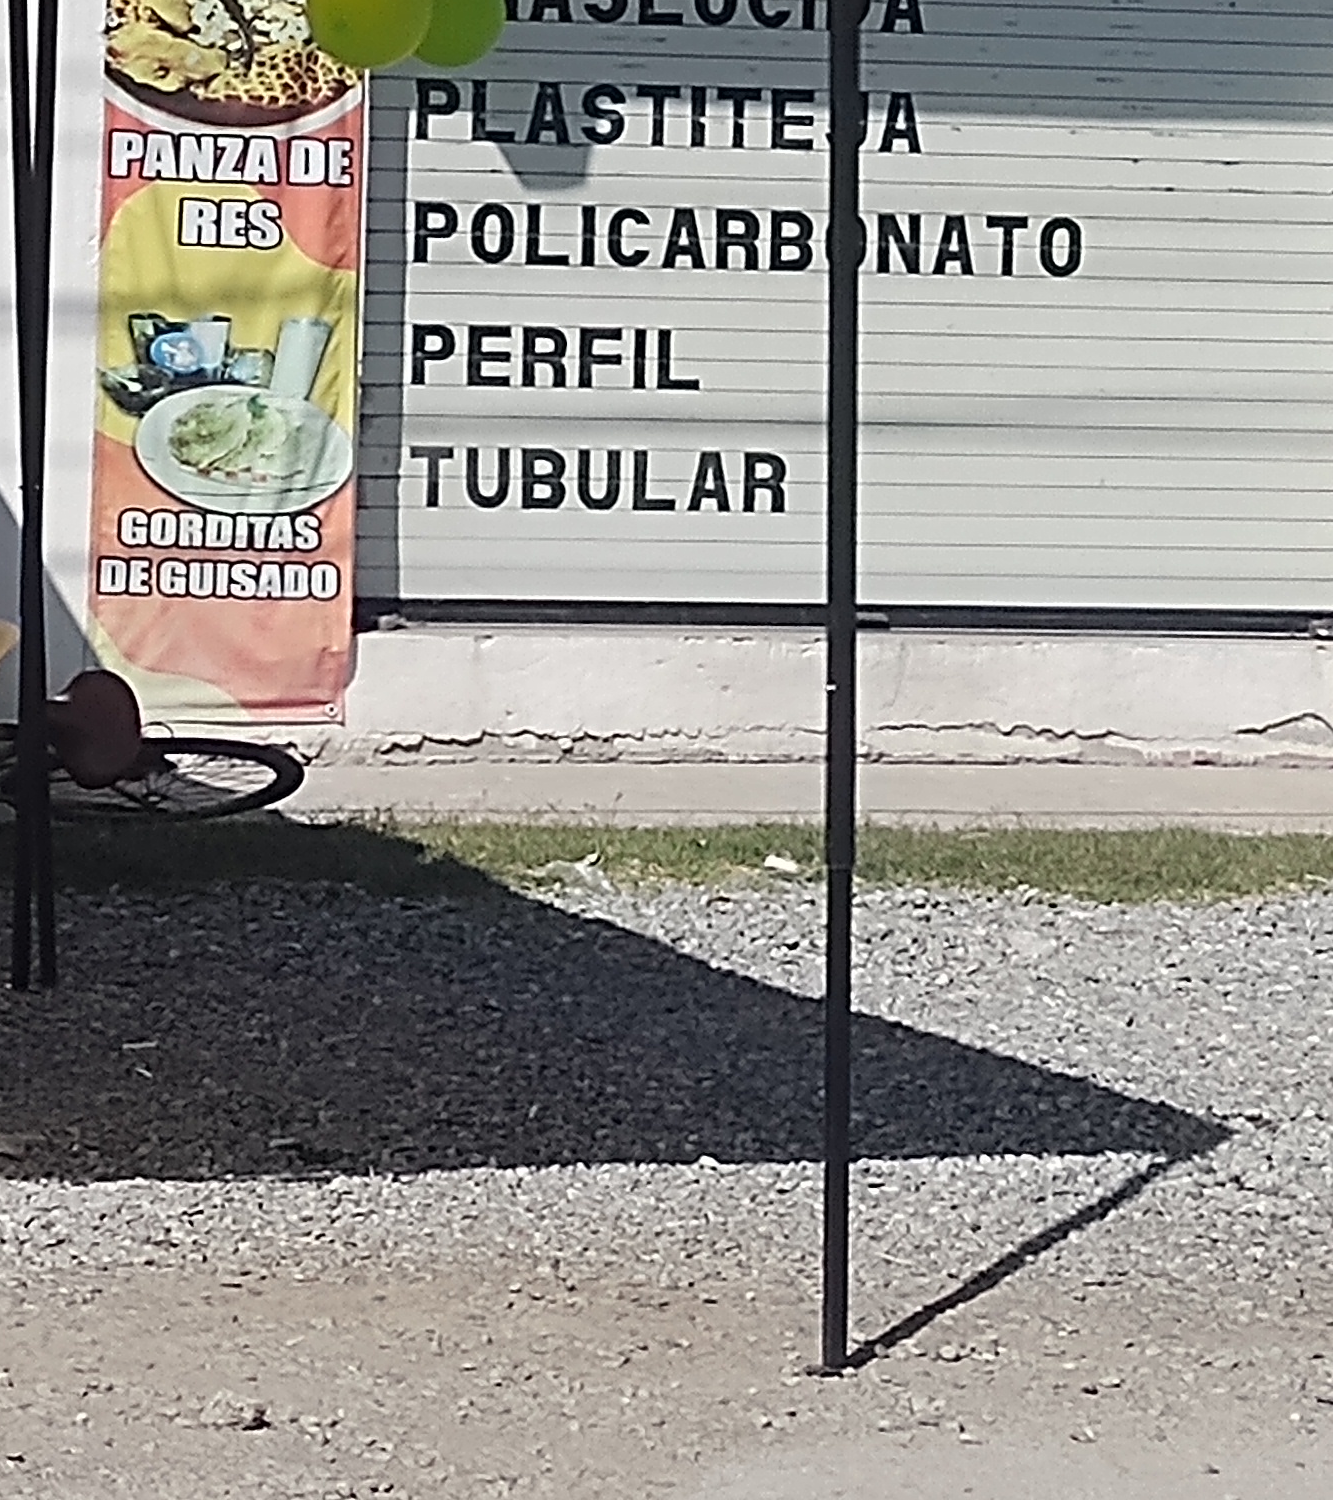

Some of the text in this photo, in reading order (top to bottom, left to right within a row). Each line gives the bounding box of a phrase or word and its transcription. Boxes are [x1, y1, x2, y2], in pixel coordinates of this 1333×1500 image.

[109, 129, 354, 188] PANZA DE
[177, 198, 283, 250] RES
[410, 323, 701, 392] PERFIL
[410, 446, 788, 514] TUBULAR
[118, 509, 321, 551] GORDITAS
[97, 557, 340, 600] DE GUISADO
